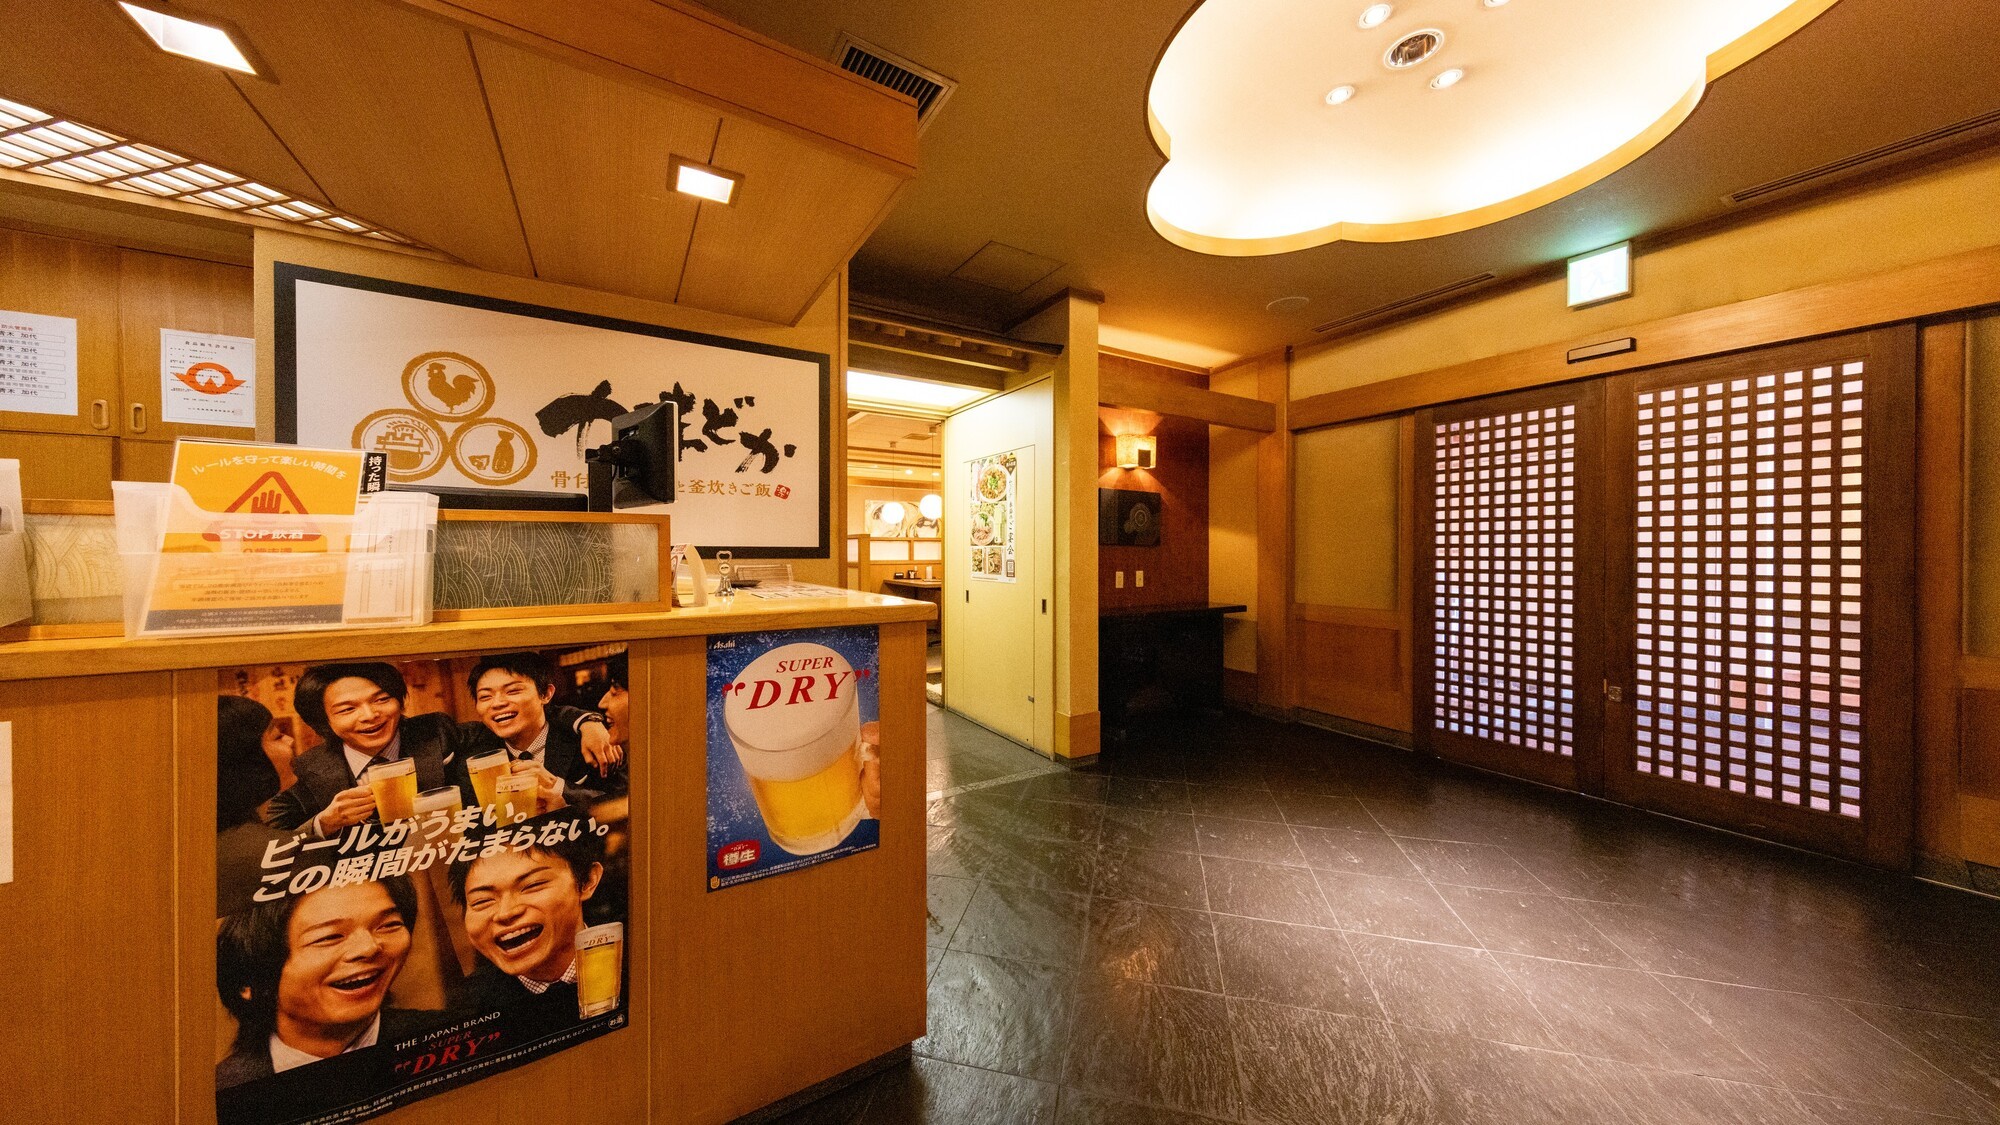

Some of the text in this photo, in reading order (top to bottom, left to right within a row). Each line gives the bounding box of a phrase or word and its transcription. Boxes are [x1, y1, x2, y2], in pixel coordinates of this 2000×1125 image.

[192, 455, 347, 480] ルールを守って楽しい時間を
[713, 640, 736, 650] Asahi
[776, 656, 834, 674] SUPER
[260, 802, 528, 869] ビールがうまい。
[252, 818, 610, 902] この瞬間がたまらない。
[394, 1011, 501, 1052] THE JAPAN BRAND
[429, 1030, 472, 1049] SUPER
